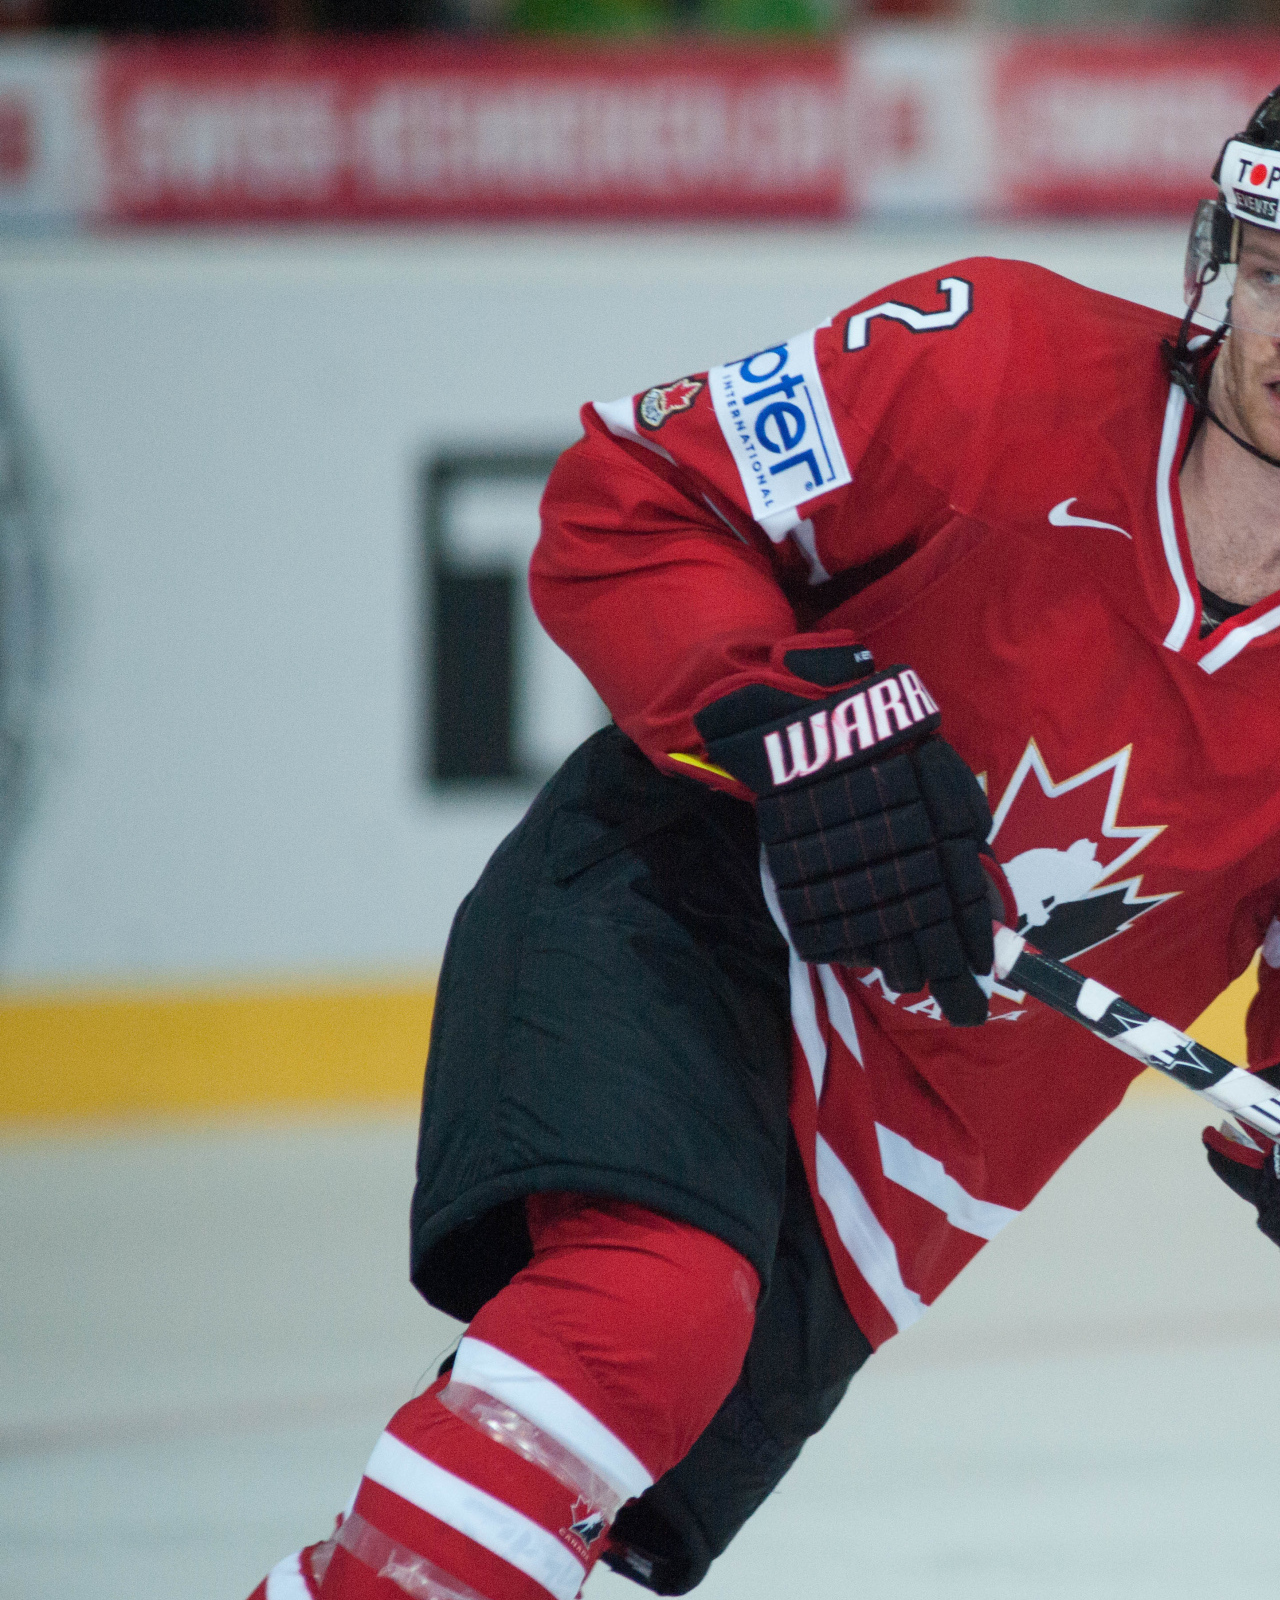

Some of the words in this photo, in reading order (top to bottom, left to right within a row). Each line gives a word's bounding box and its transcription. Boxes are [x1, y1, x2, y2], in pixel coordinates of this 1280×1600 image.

[1236, 193, 1277, 217] EVENTS
[843, 277, 972, 352] 2
[722, 374, 775, 508] INTERNATIONAL
